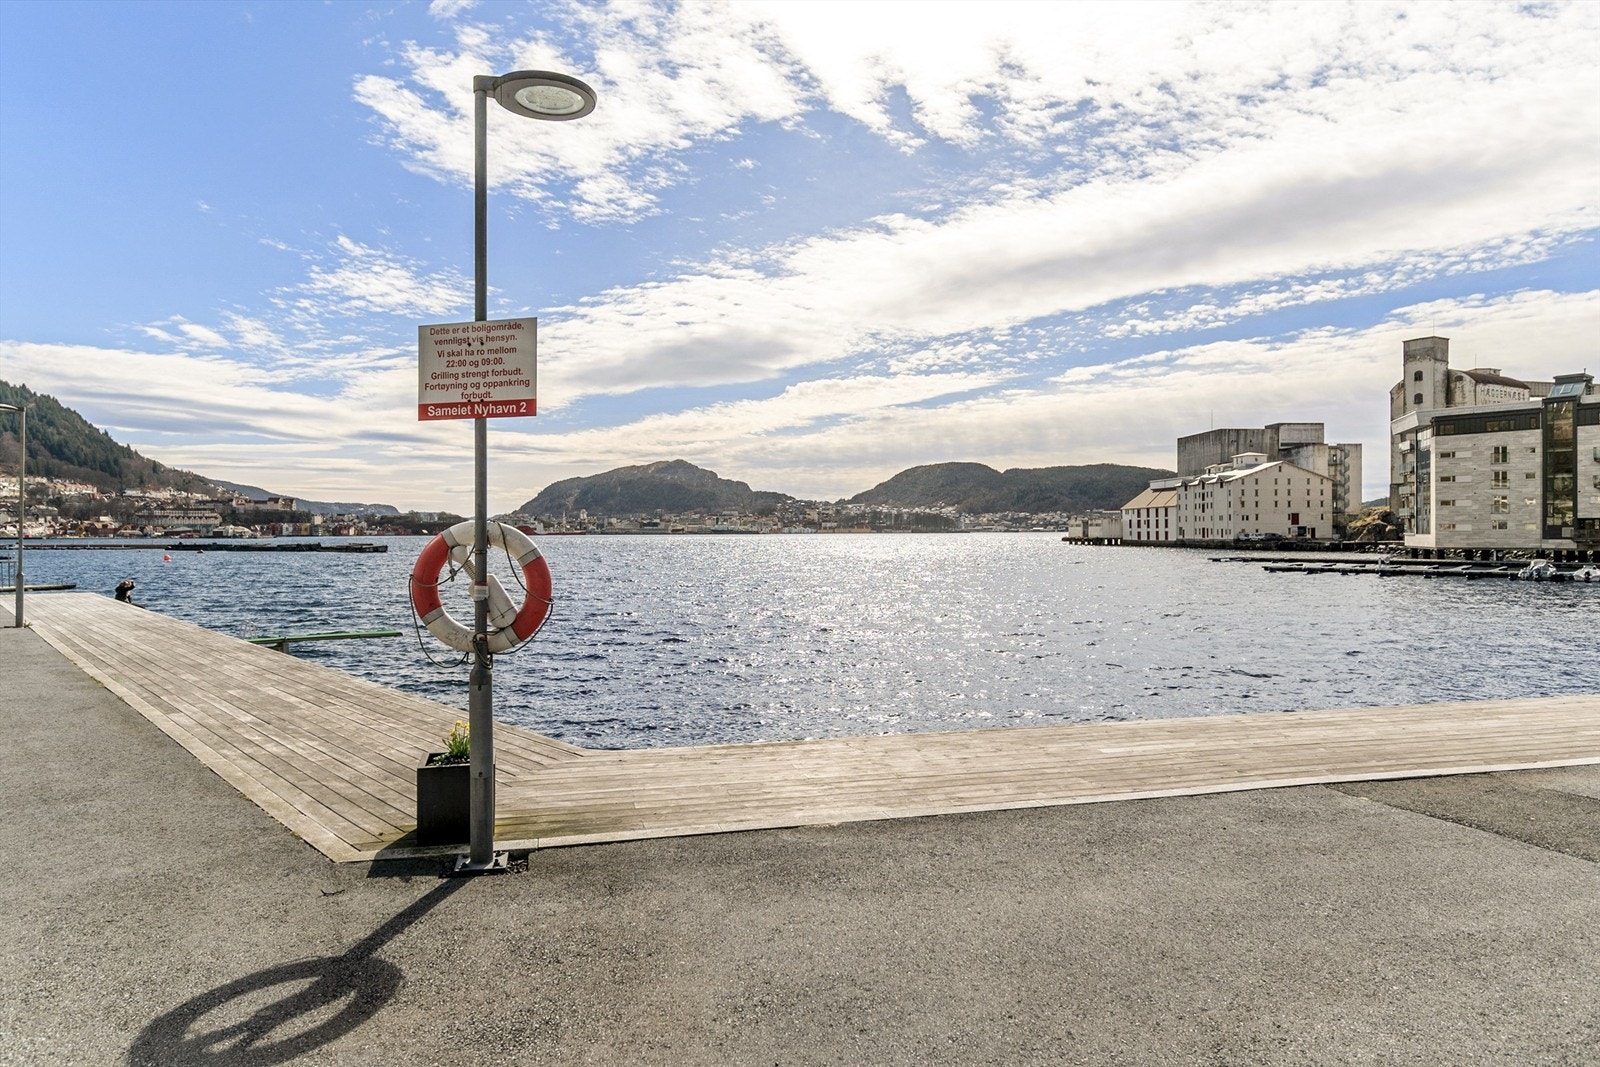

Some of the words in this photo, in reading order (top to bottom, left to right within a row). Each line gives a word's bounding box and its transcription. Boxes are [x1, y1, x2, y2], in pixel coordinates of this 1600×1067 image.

[472, 322, 524, 333] boligområde,
[434, 337, 470, 346] vennligst
[446, 360, 466, 368] 22:00
[431, 372, 458, 380] Grilling
[425, 382, 467, 391] Fortøyning
[470, 381, 480, 390] og
[483, 379, 530, 389] oppankring
[428, 404, 471, 416] Sameiet
[475, 404, 516, 416] Nyhavn
[520, 402, 526, 412] 2
